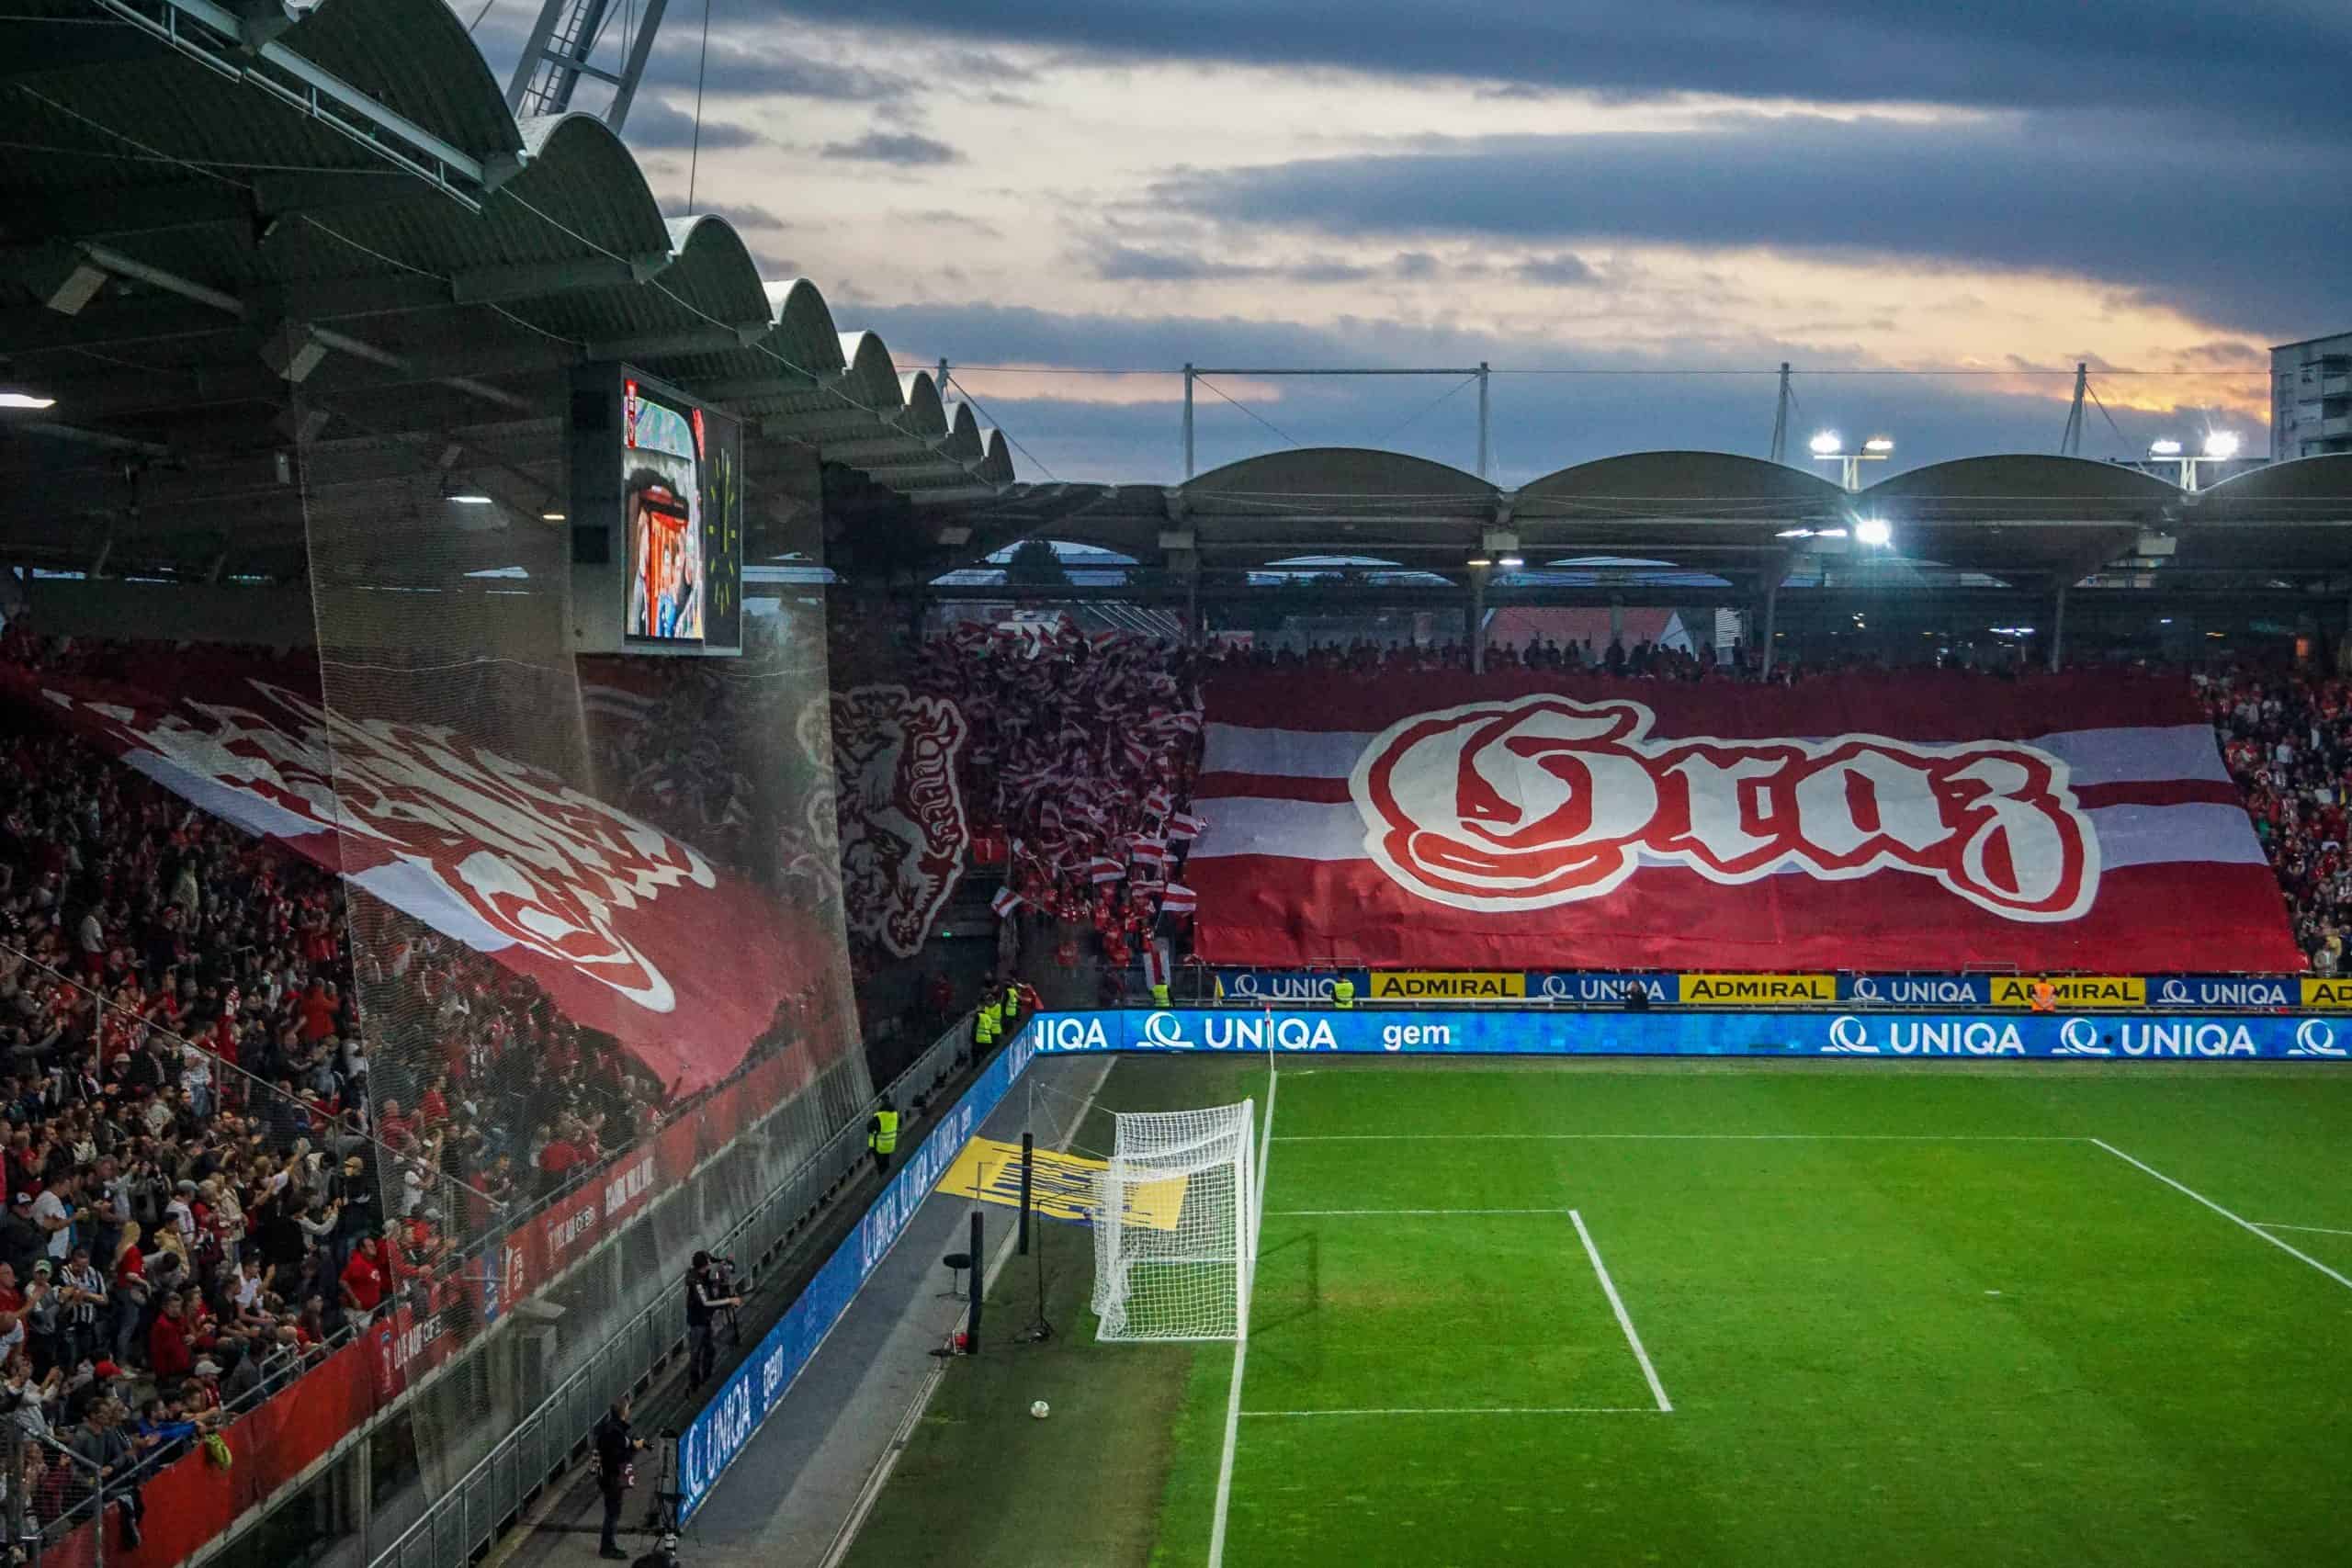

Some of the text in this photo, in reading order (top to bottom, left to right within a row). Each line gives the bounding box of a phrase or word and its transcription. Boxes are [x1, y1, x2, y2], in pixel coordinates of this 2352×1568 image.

[1358, 696, 2093, 919] Graz
[1272, 978, 1337, 998] UNIQ
[1381, 977, 1518, 998] ADMIRAL
[1690, 980, 1828, 999] ADMIRAL
[1892, 982, 1976, 1002] UNIQA
[2201, 984, 2287, 1004] UNIQA
[1205, 1018, 1337, 1049] UNIQA
[1383, 1024, 1450, 1049] gem
[1891, 1022, 2025, 1054] UNIQA
[2121, 1024, 2256, 1055] UNIQA
[707, 1344, 784, 1480] UNIQA gem
